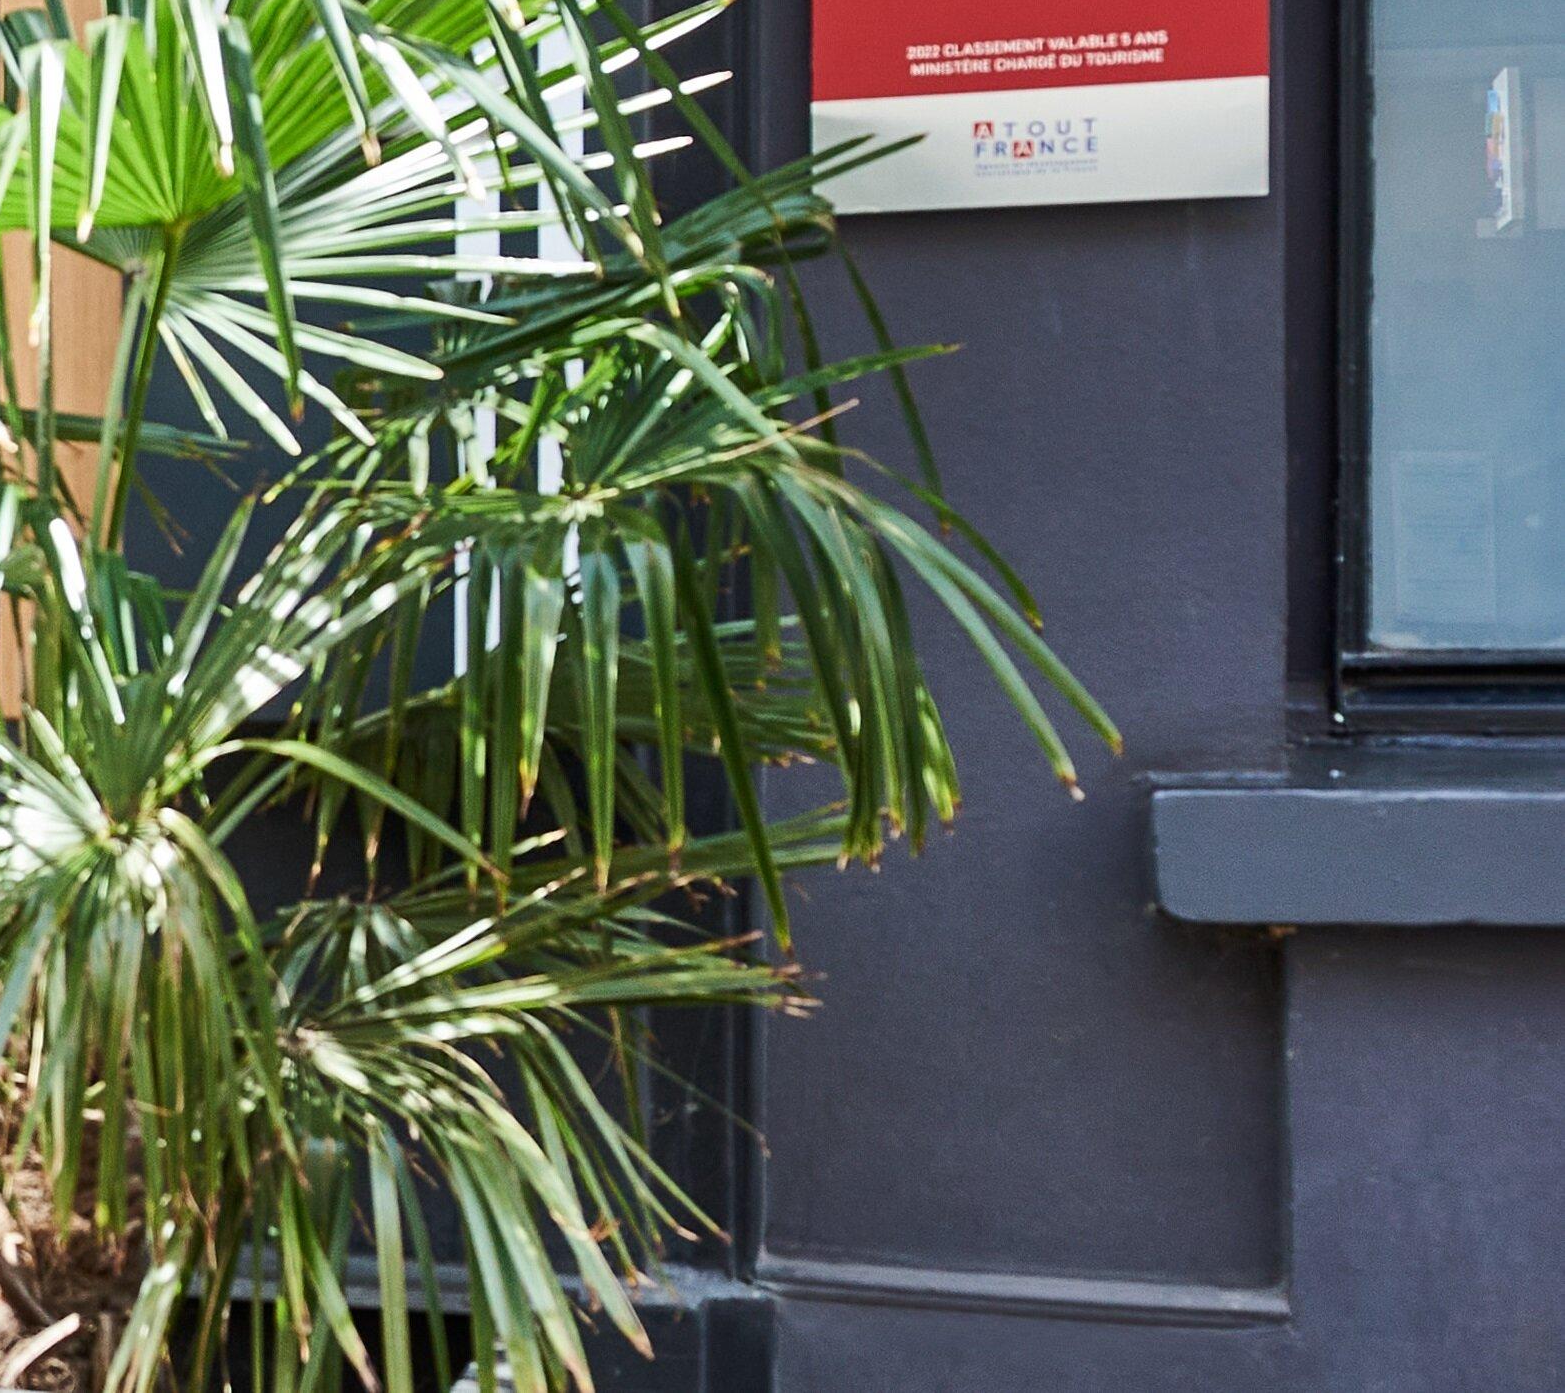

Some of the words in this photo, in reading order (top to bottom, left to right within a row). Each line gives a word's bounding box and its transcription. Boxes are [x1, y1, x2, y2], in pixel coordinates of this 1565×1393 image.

[942, 37, 1046, 58] CLASSEMENT
[1046, 33, 1117, 51] VALABLE
[1133, 29, 1169, 45] ANS
[1059, 52, 1083, 68] DU
[1085, 46, 1164, 67] TOURISME
[973, 135, 1099, 160] FRANCE
